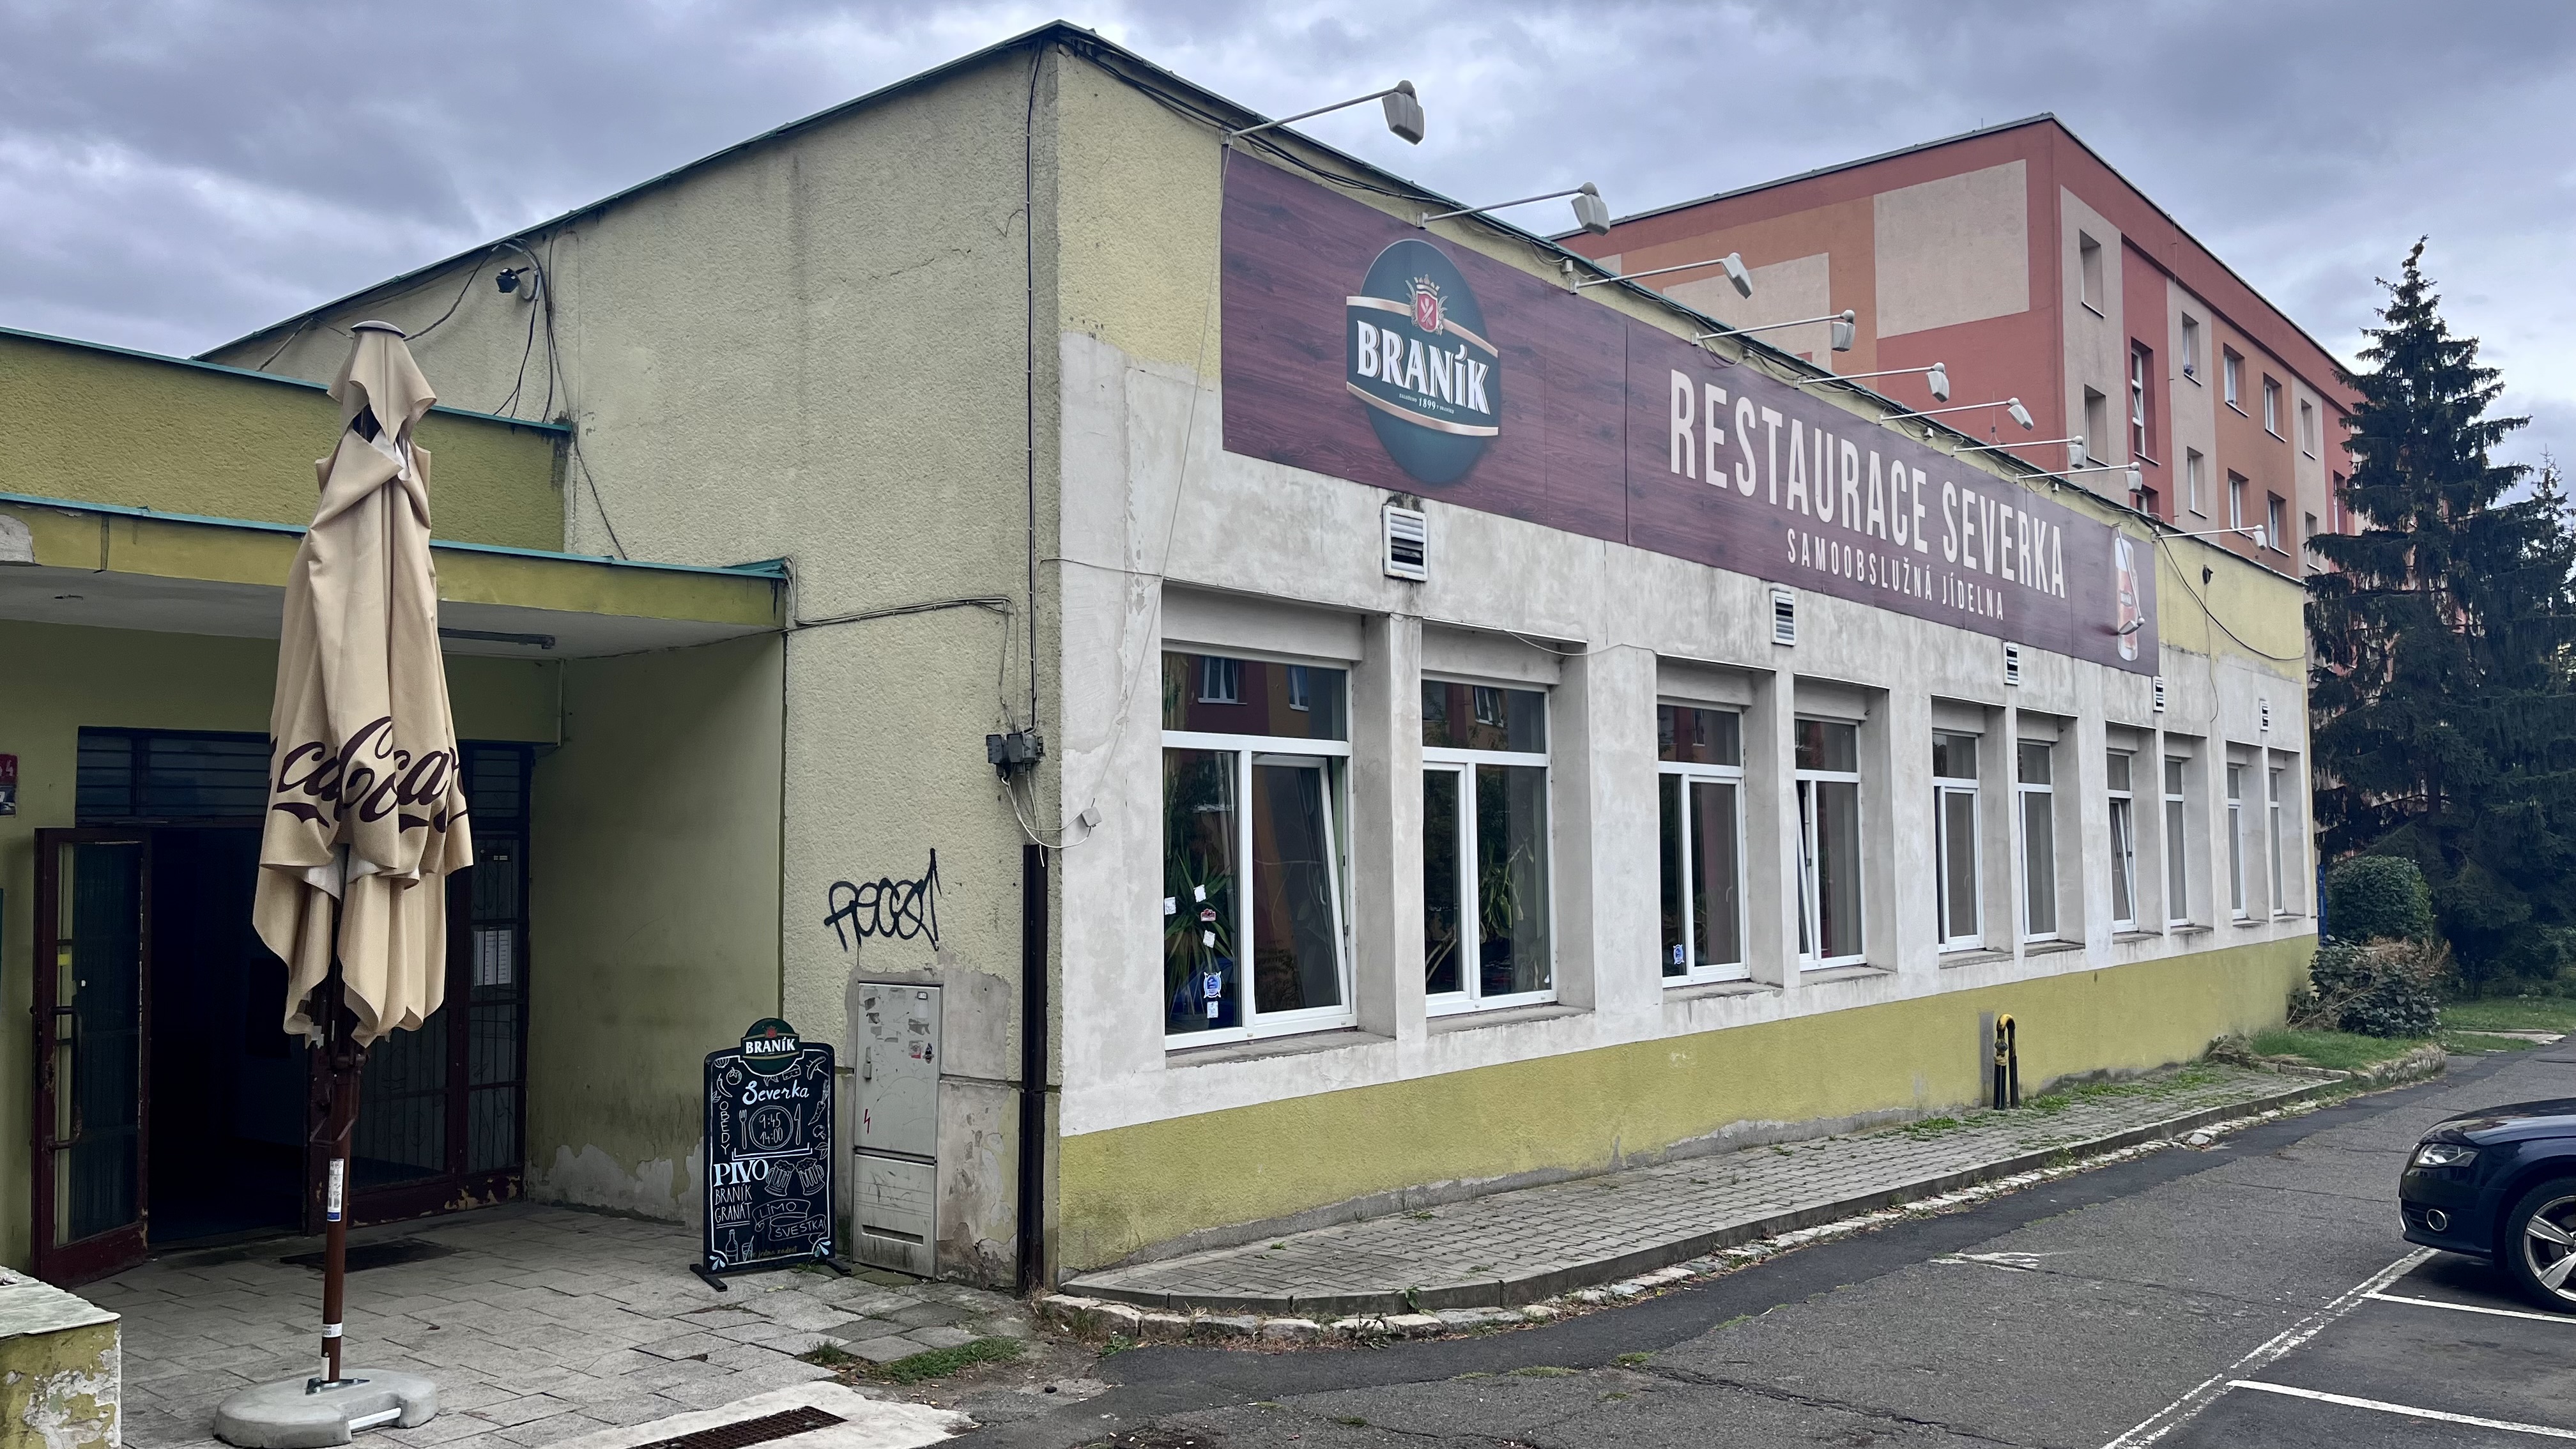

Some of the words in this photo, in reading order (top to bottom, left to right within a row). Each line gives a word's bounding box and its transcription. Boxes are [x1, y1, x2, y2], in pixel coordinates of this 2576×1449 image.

[1357, 320, 1491, 415] BRANÍK
[1418, 397, 1436, 410] 1899
[1671, 369, 1928, 554] RESTAURACE
[1943, 481, 2065, 599] SEVERKA
[1788, 528, 1932, 601] SAMOOBSLUŽNÁ
[1942, 572, 2004, 620] JÍDELNA
[745, 1036, 796, 1054] BRANÍK
[742, 1080, 809, 1105] Severka
[758, 1112, 781, 1129] 9:45
[760, 1127, 783, 1145] 14:00
[713, 1158, 769, 1187] PIVO
[714, 1183, 753, 1206] BRANÍK
[714, 1201, 753, 1223] GRANÁT
[775, 1218, 825, 1238] ŠVESTKA
